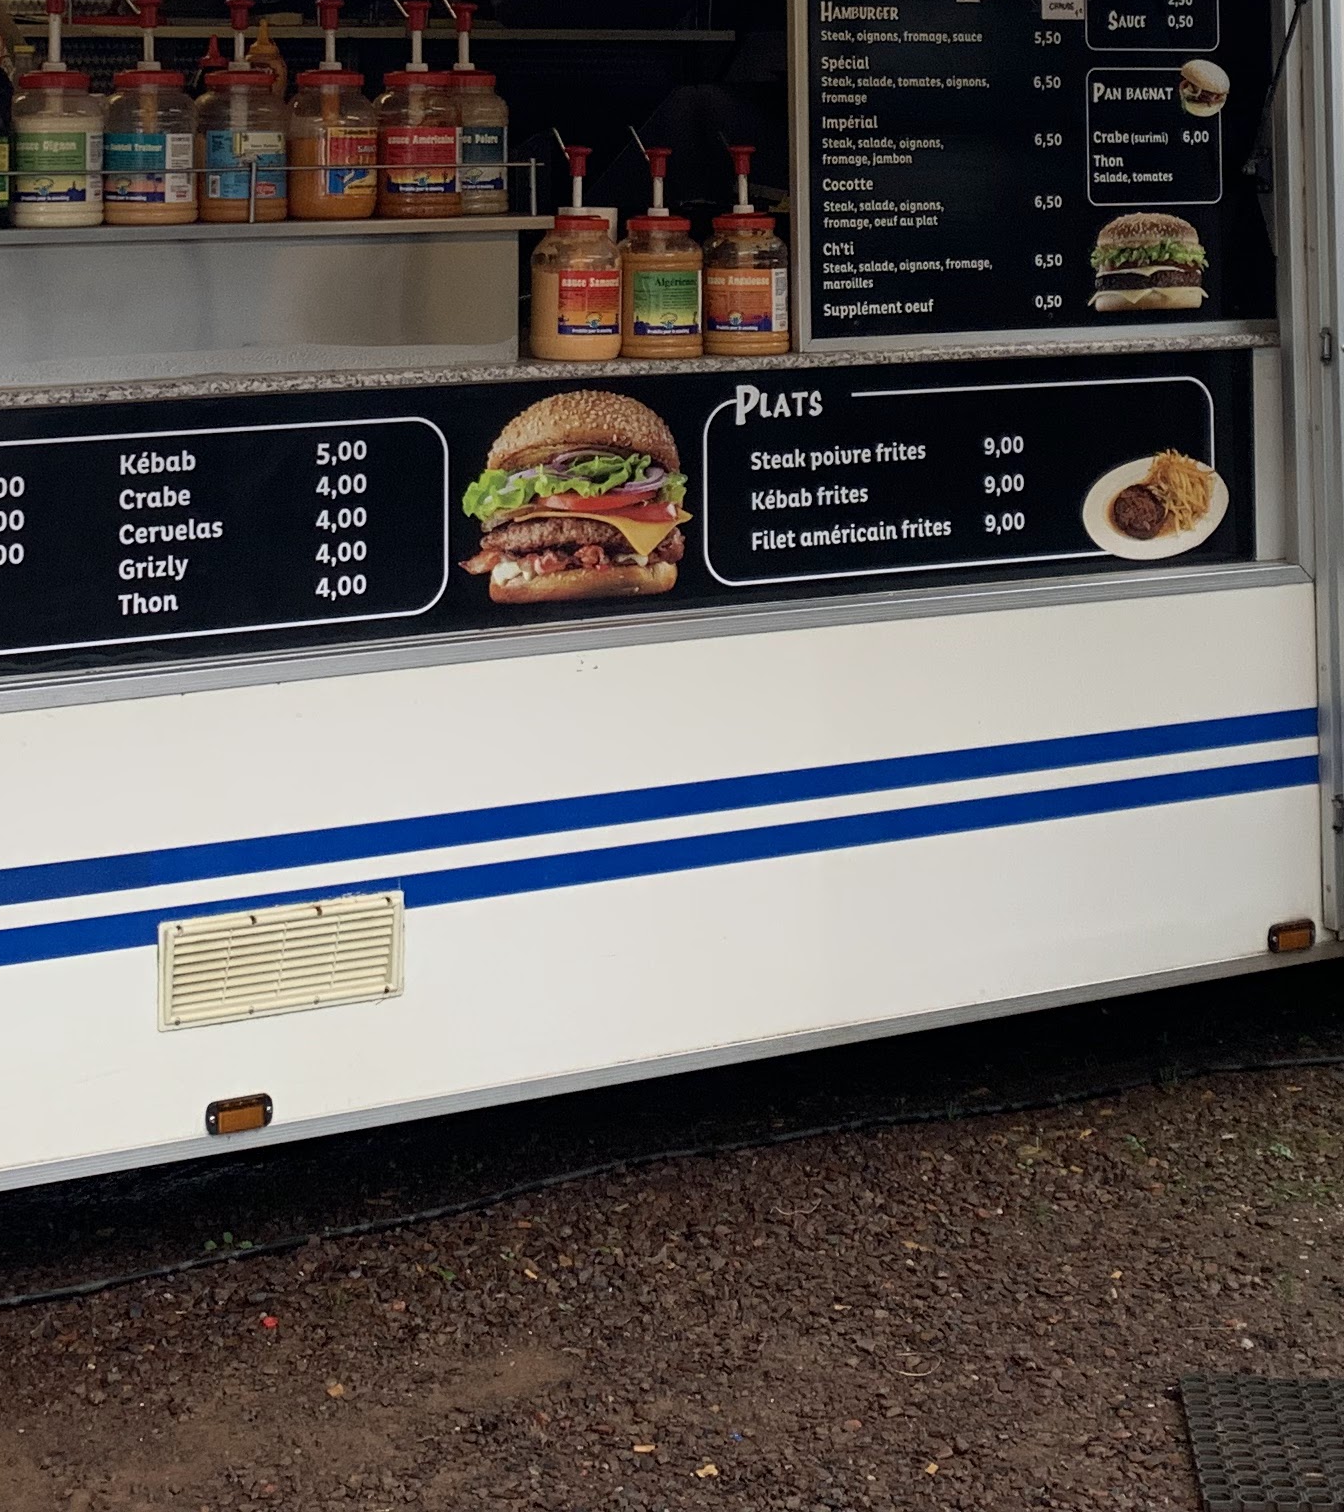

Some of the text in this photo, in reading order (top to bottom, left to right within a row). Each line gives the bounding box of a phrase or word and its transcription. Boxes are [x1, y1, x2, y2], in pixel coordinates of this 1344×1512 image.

[1168, 15, 1194, 29] 0,50
[820, 30, 1061, 47] Steak, oignons, fromage, sauce 5,50
[821, 56, 870, 72] Spécial
[821, 75, 1061, 90] Steak, salade, tomates, oignons, 6,50
[821, 92, 868, 104] fromage
[822, 115, 878, 132] Impérial
[822, 133, 1062, 151] Steak, salade, oignons, 6,50
[1093, 130, 1209, 145] Crabe (surimi) 6,00
[822, 152, 912, 167] fromage, jambon
[1094, 155, 1124, 168] Thon
[822, 178, 874, 191] Cocotte
[1094, 171, 1173, 184] Salade, tomates
[823, 195, 1062, 214] Steak, salade, oignons, 6,50
[823, 215, 938, 230] fromage, oeuf au plat
[823, 242, 855, 256] Ch'ti
[823, 253, 1063, 276] Steak, salade, oignons, fromage, 6,50
[823, 277, 874, 290] maroilles
[823, 295, 1062, 318] Supplément oeuf 0,50
[119, 440, 368, 476] Kébab 5,00
[750, 435, 1025, 472] Steak poivre frites 9,00
[118, 473, 368, 510] Crabe 4,00
[751, 474, 1025, 512] Kébab frites 9,00
[118, 506, 368, 545] Cervelas 4,00
[751, 512, 1026, 553] Filet américain frites 9,00
[118, 540, 368, 582] Grizly 4,00
[118, 574, 368, 615] Thon 4,00
